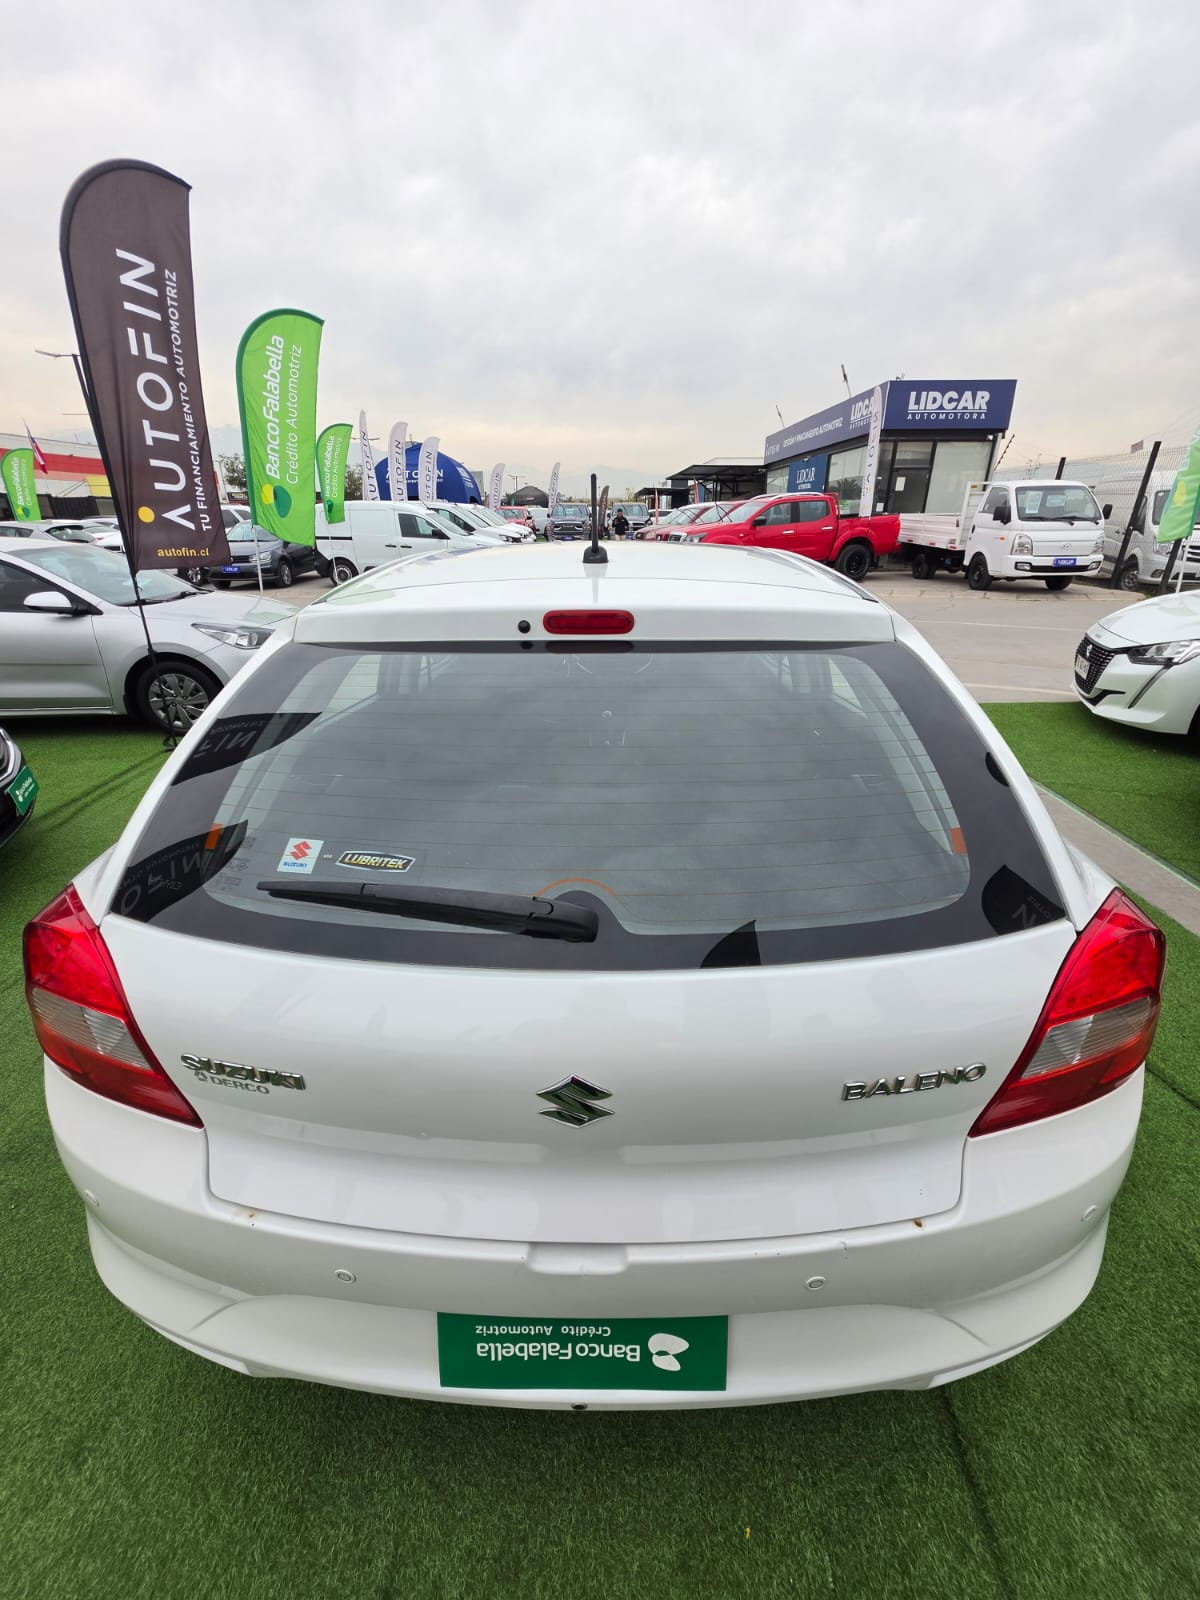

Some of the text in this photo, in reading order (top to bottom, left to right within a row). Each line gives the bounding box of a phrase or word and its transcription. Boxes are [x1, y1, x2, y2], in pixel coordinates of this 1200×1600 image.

[115, 248, 196, 531] AUTOFIN
[164, 268, 212, 531] TU FINANCIAMIENTO AUTOMOTRIZ
[262, 335, 285, 480] BancoFalabella
[850, 396, 873, 420] LIDCA
[907, 390, 991, 410] LIDCAR
[286, 344, 302, 484] Crédito Automotriz
[425, 451, 433, 499] UTOFIN
[157, 547, 209, 557] autofin.cl
[344, 853, 408, 869] LUBRITEK
[180, 1053, 307, 1090] SUZUKI
[211, 1075, 270, 1094] DERCO
[841, 1062, 987, 1101] BALENO
[475, 1325, 612, 1337] Crédito Automotriz
